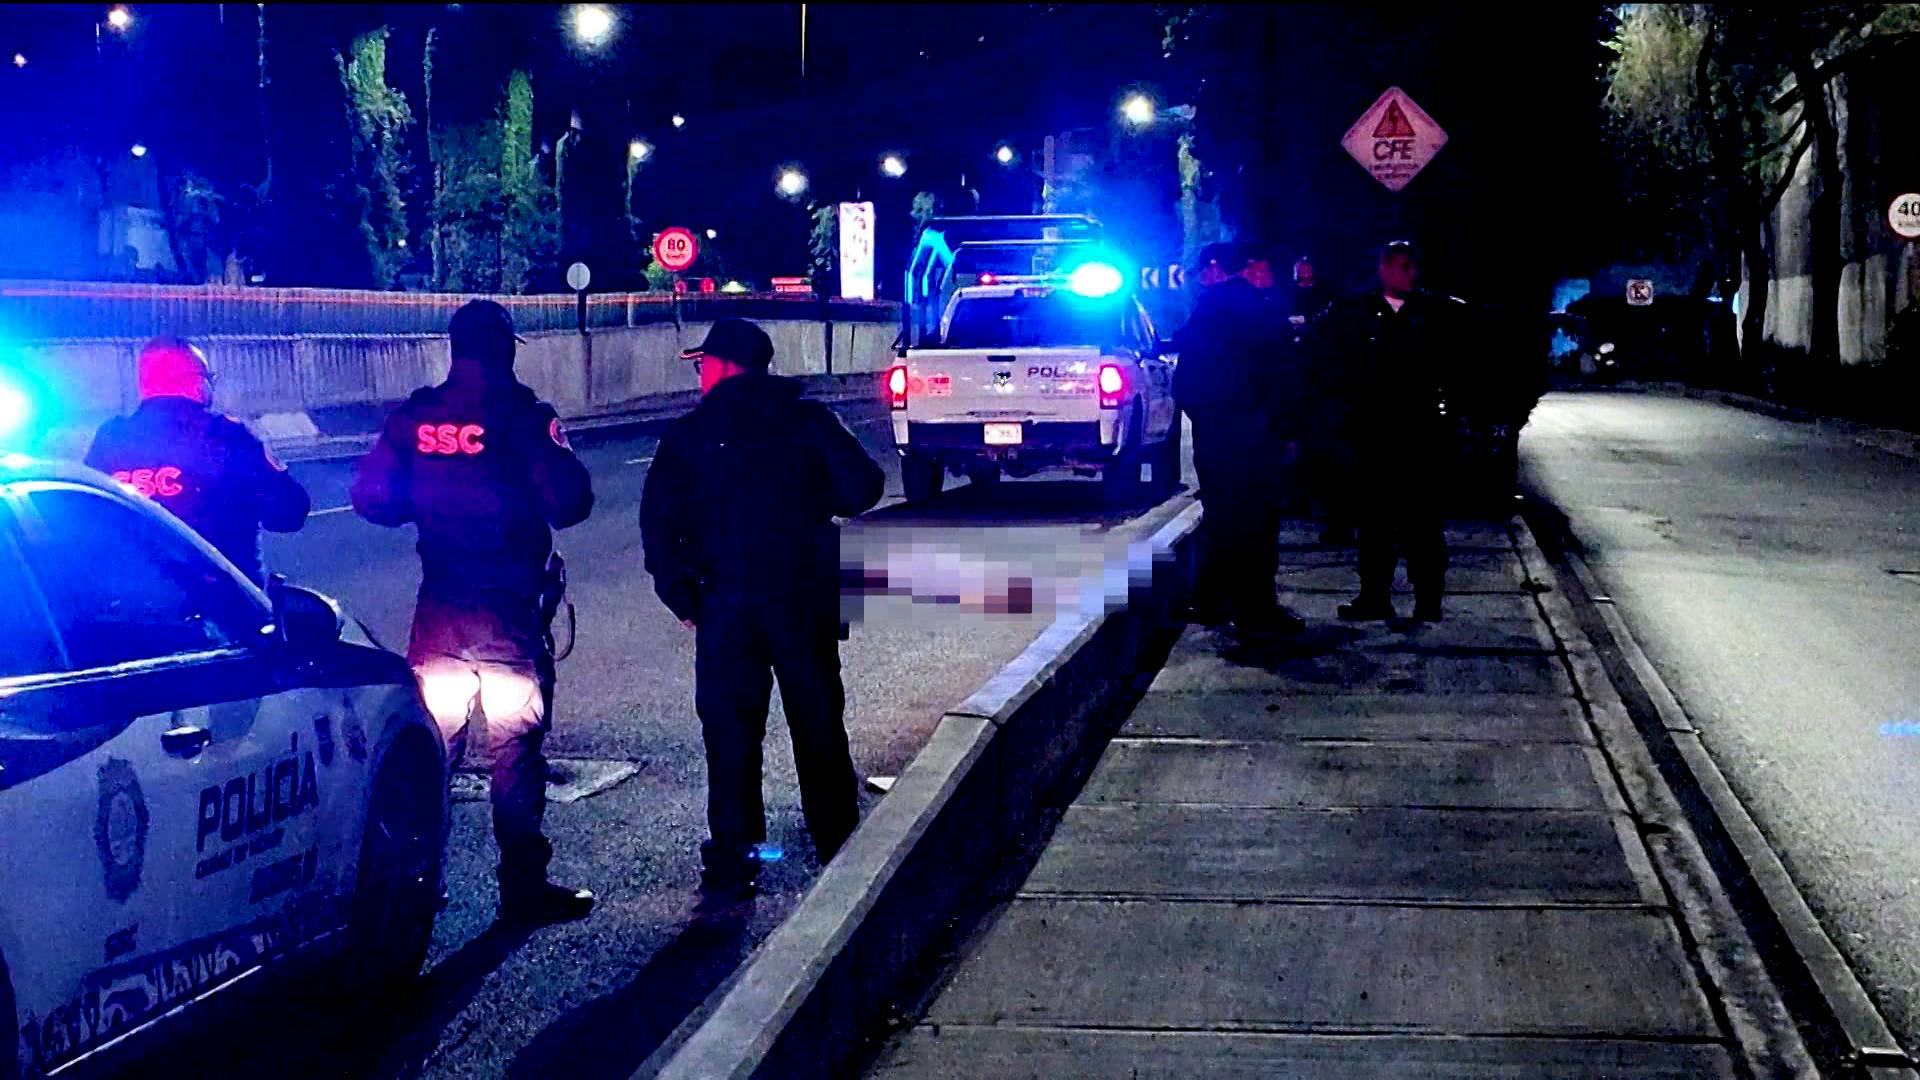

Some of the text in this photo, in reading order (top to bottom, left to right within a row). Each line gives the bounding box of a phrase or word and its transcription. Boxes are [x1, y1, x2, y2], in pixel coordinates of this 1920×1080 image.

[1374, 139, 1416, 161] CFE
[667, 238, 686, 251] 80
[417, 424, 485, 454] SSC
